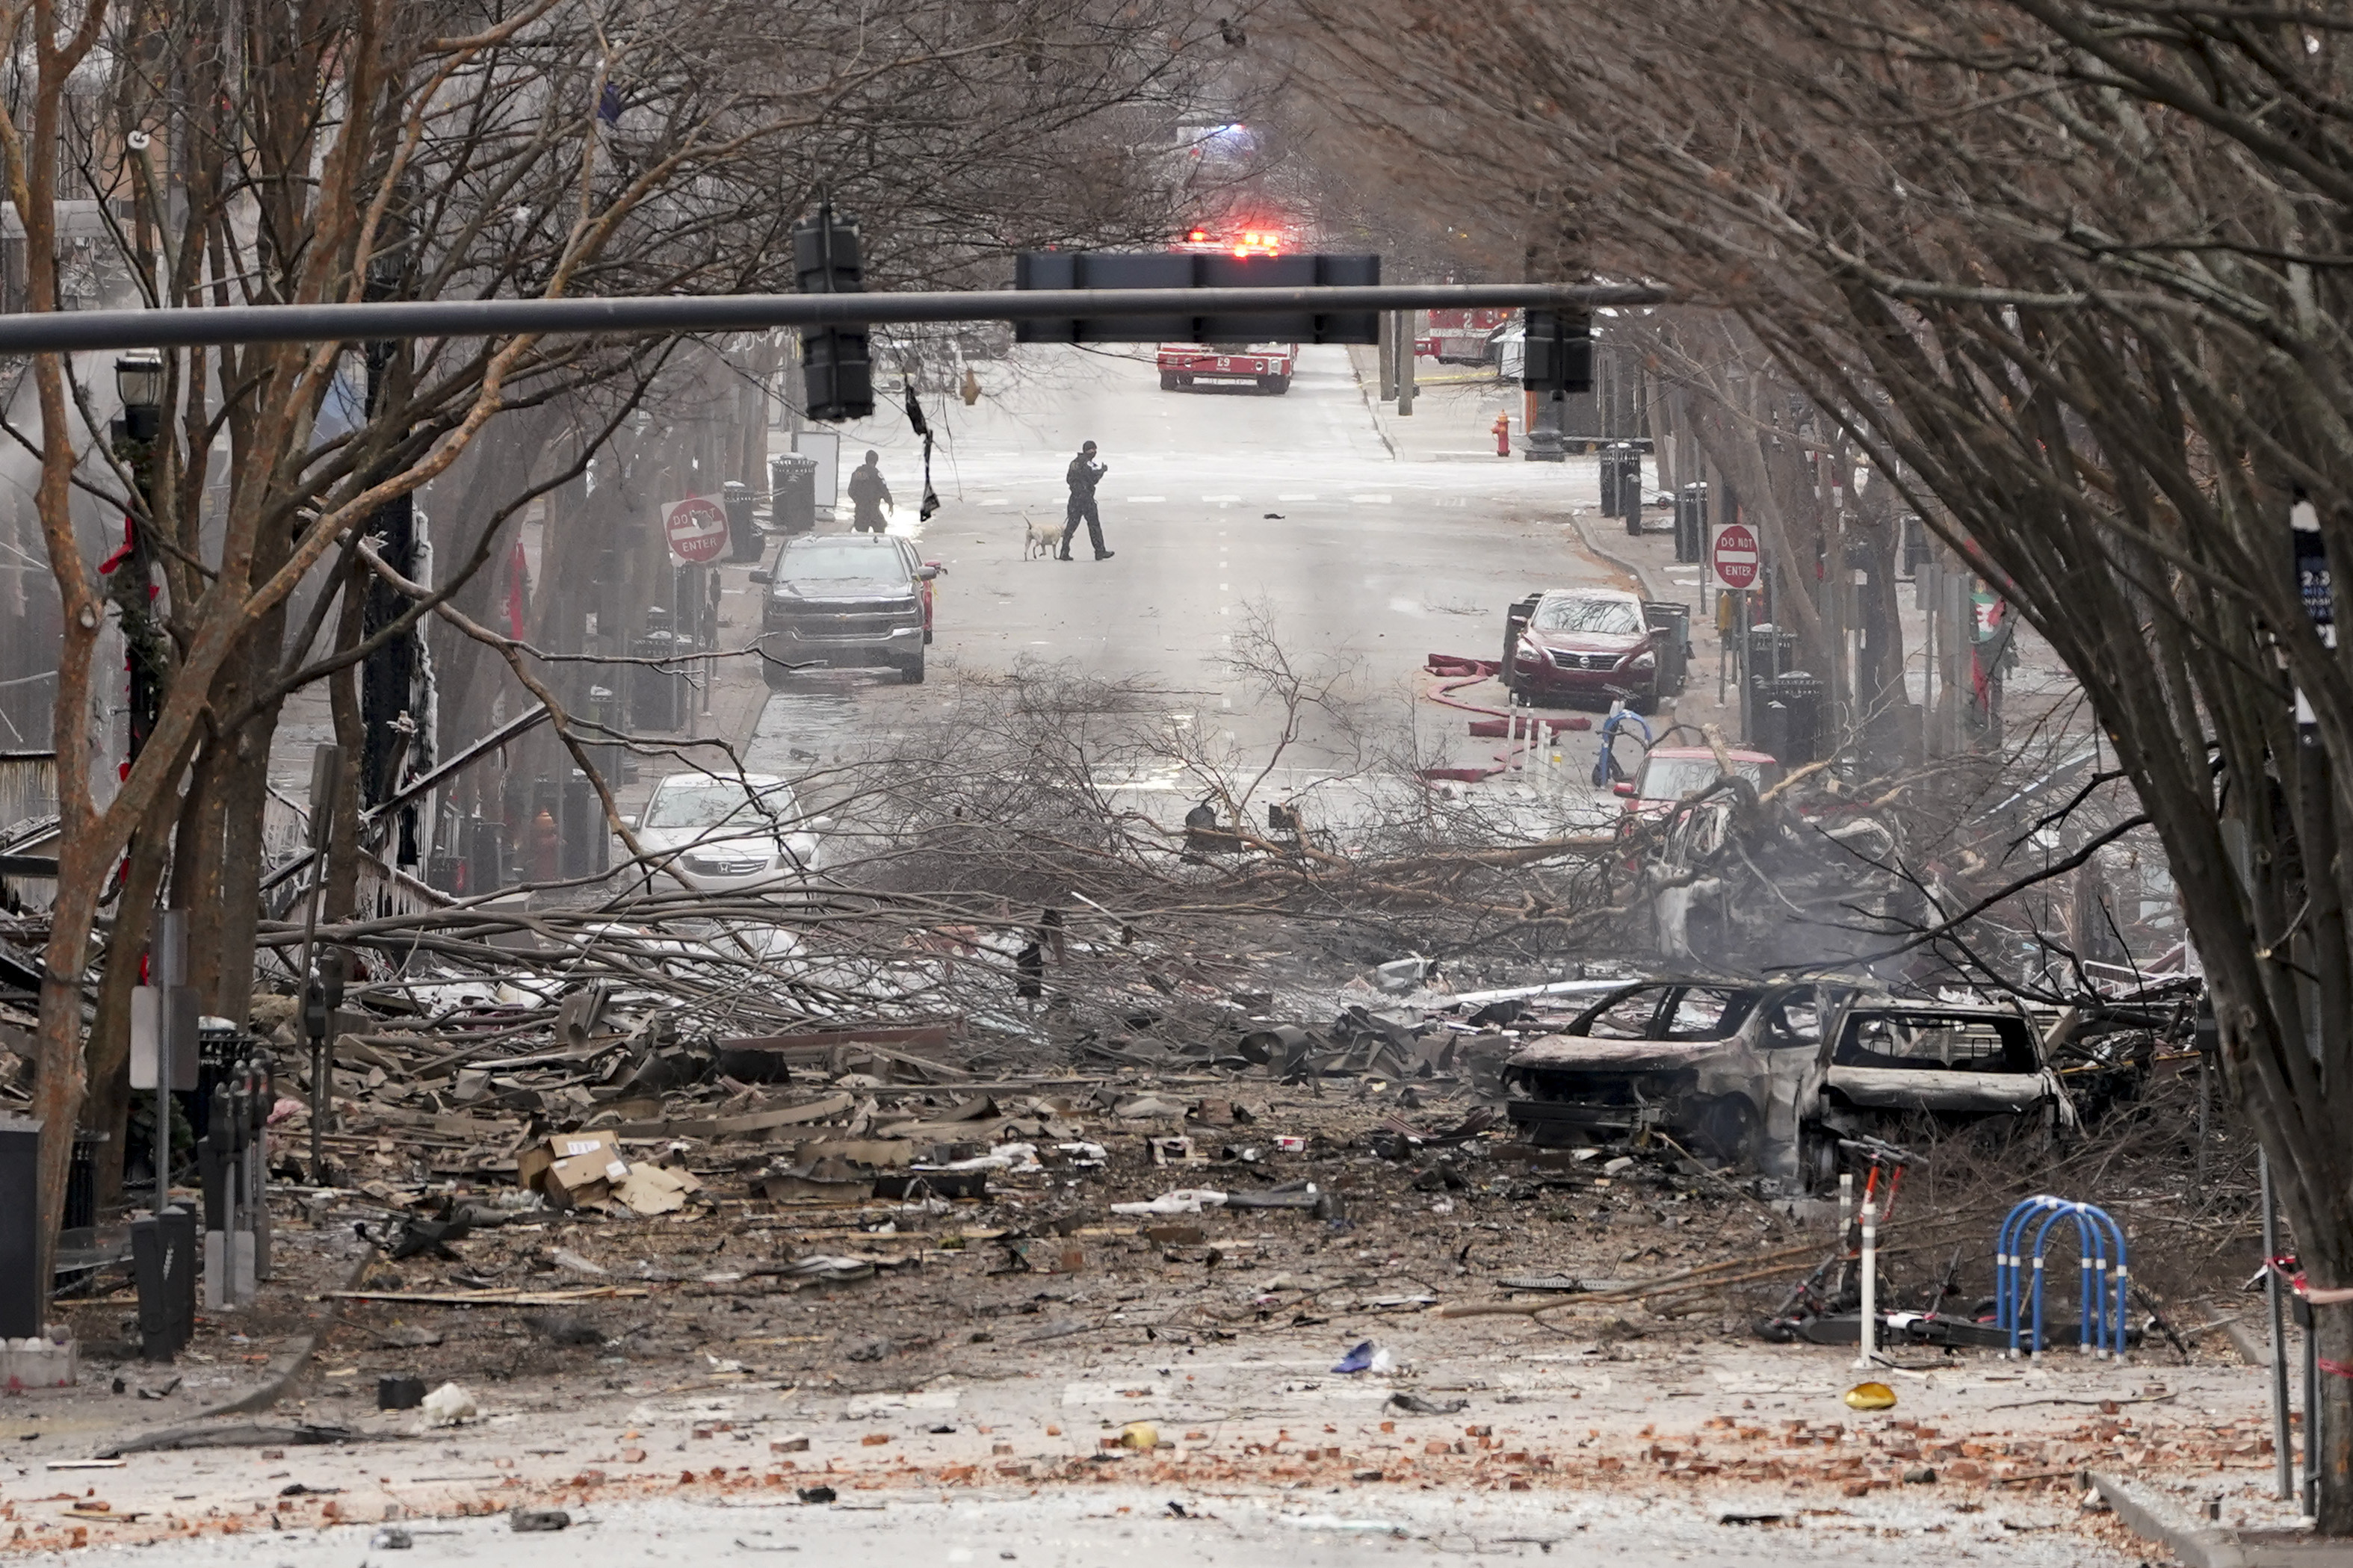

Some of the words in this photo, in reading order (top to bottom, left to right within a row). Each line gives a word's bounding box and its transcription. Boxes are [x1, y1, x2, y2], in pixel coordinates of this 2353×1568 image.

[673, 514, 688, 526] DO
[682, 537, 717, 552] ENTER
[1721, 537, 1735, 547] DO
[1738, 537, 1753, 548] NOT
[1725, 565, 1751, 576] ENTER
